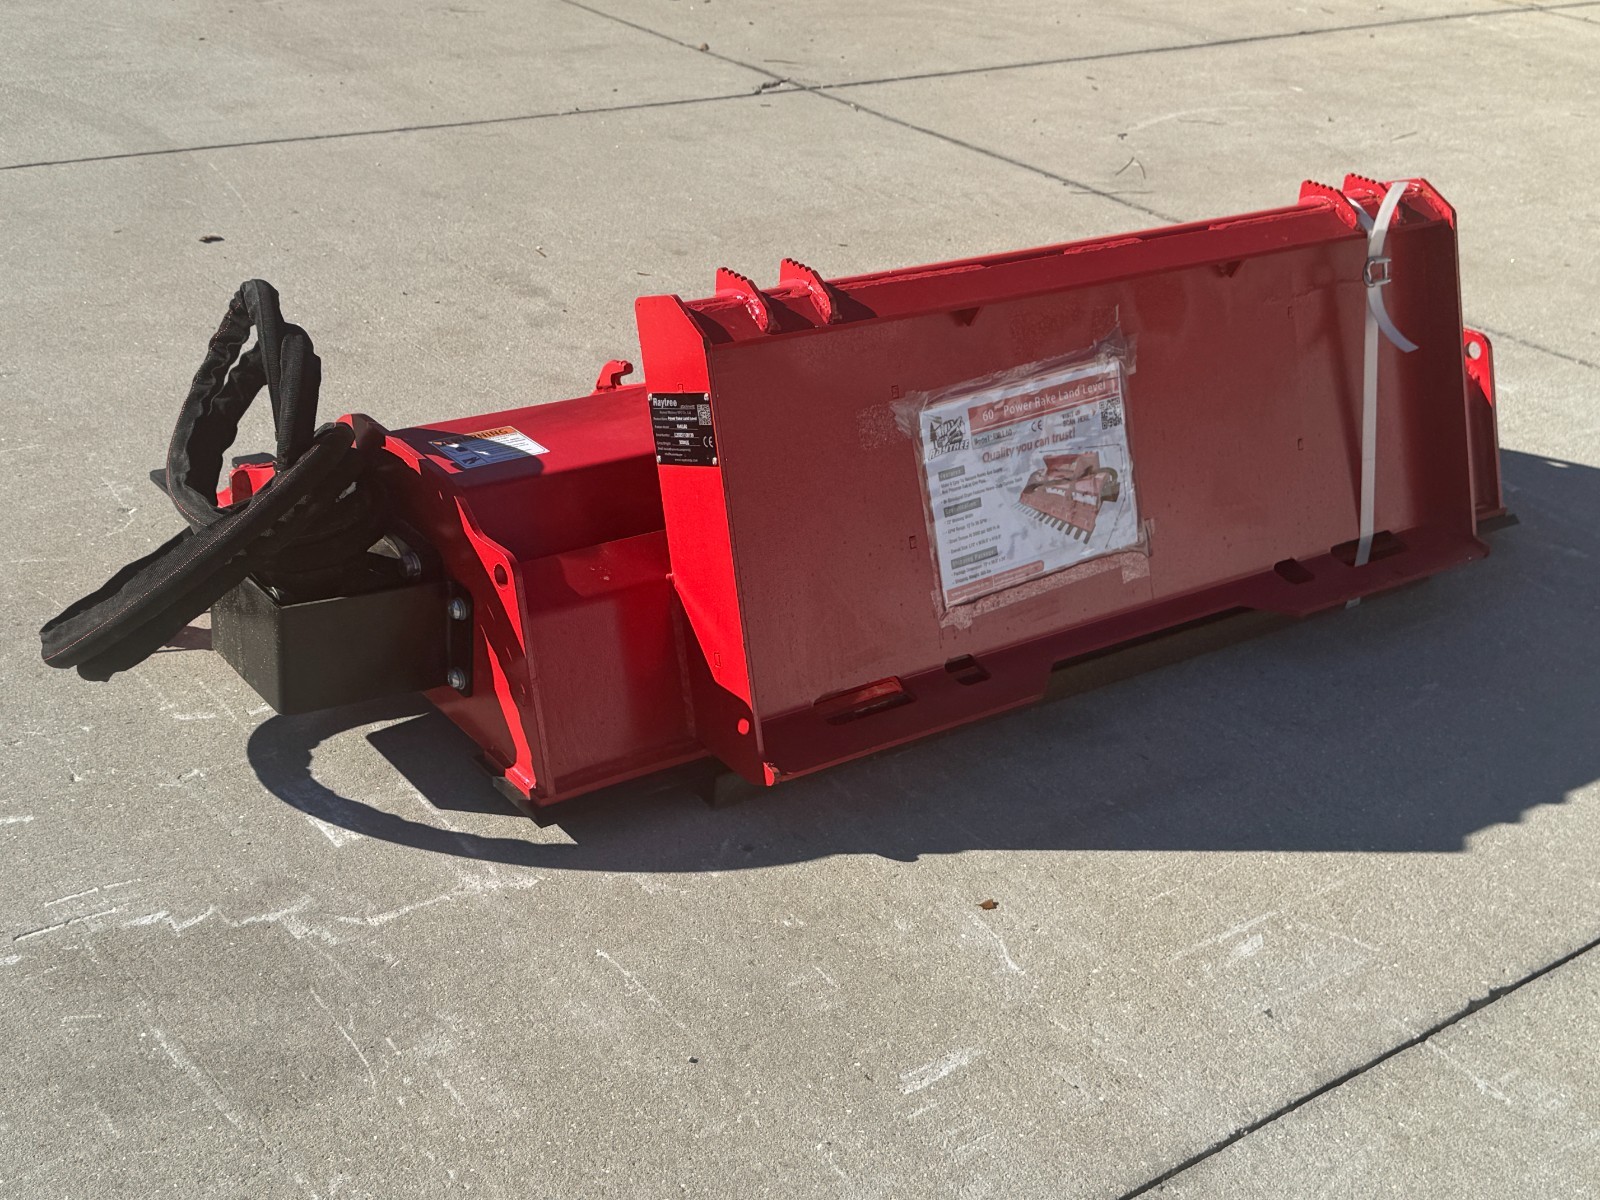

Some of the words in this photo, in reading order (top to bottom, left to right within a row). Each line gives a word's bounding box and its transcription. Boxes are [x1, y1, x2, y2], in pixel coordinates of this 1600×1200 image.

[652, 398, 678, 408] Raytree
[1004, 401, 1032, 417] Power
[1034, 394, 1056, 408] Rake
[1058, 385, 1080, 401] Land
[982, 446, 1016, 463] Quality
[1016, 440, 1033, 454] you
[1034, 436, 1050, 448] can
[1052, 428, 1076, 442] trust!
